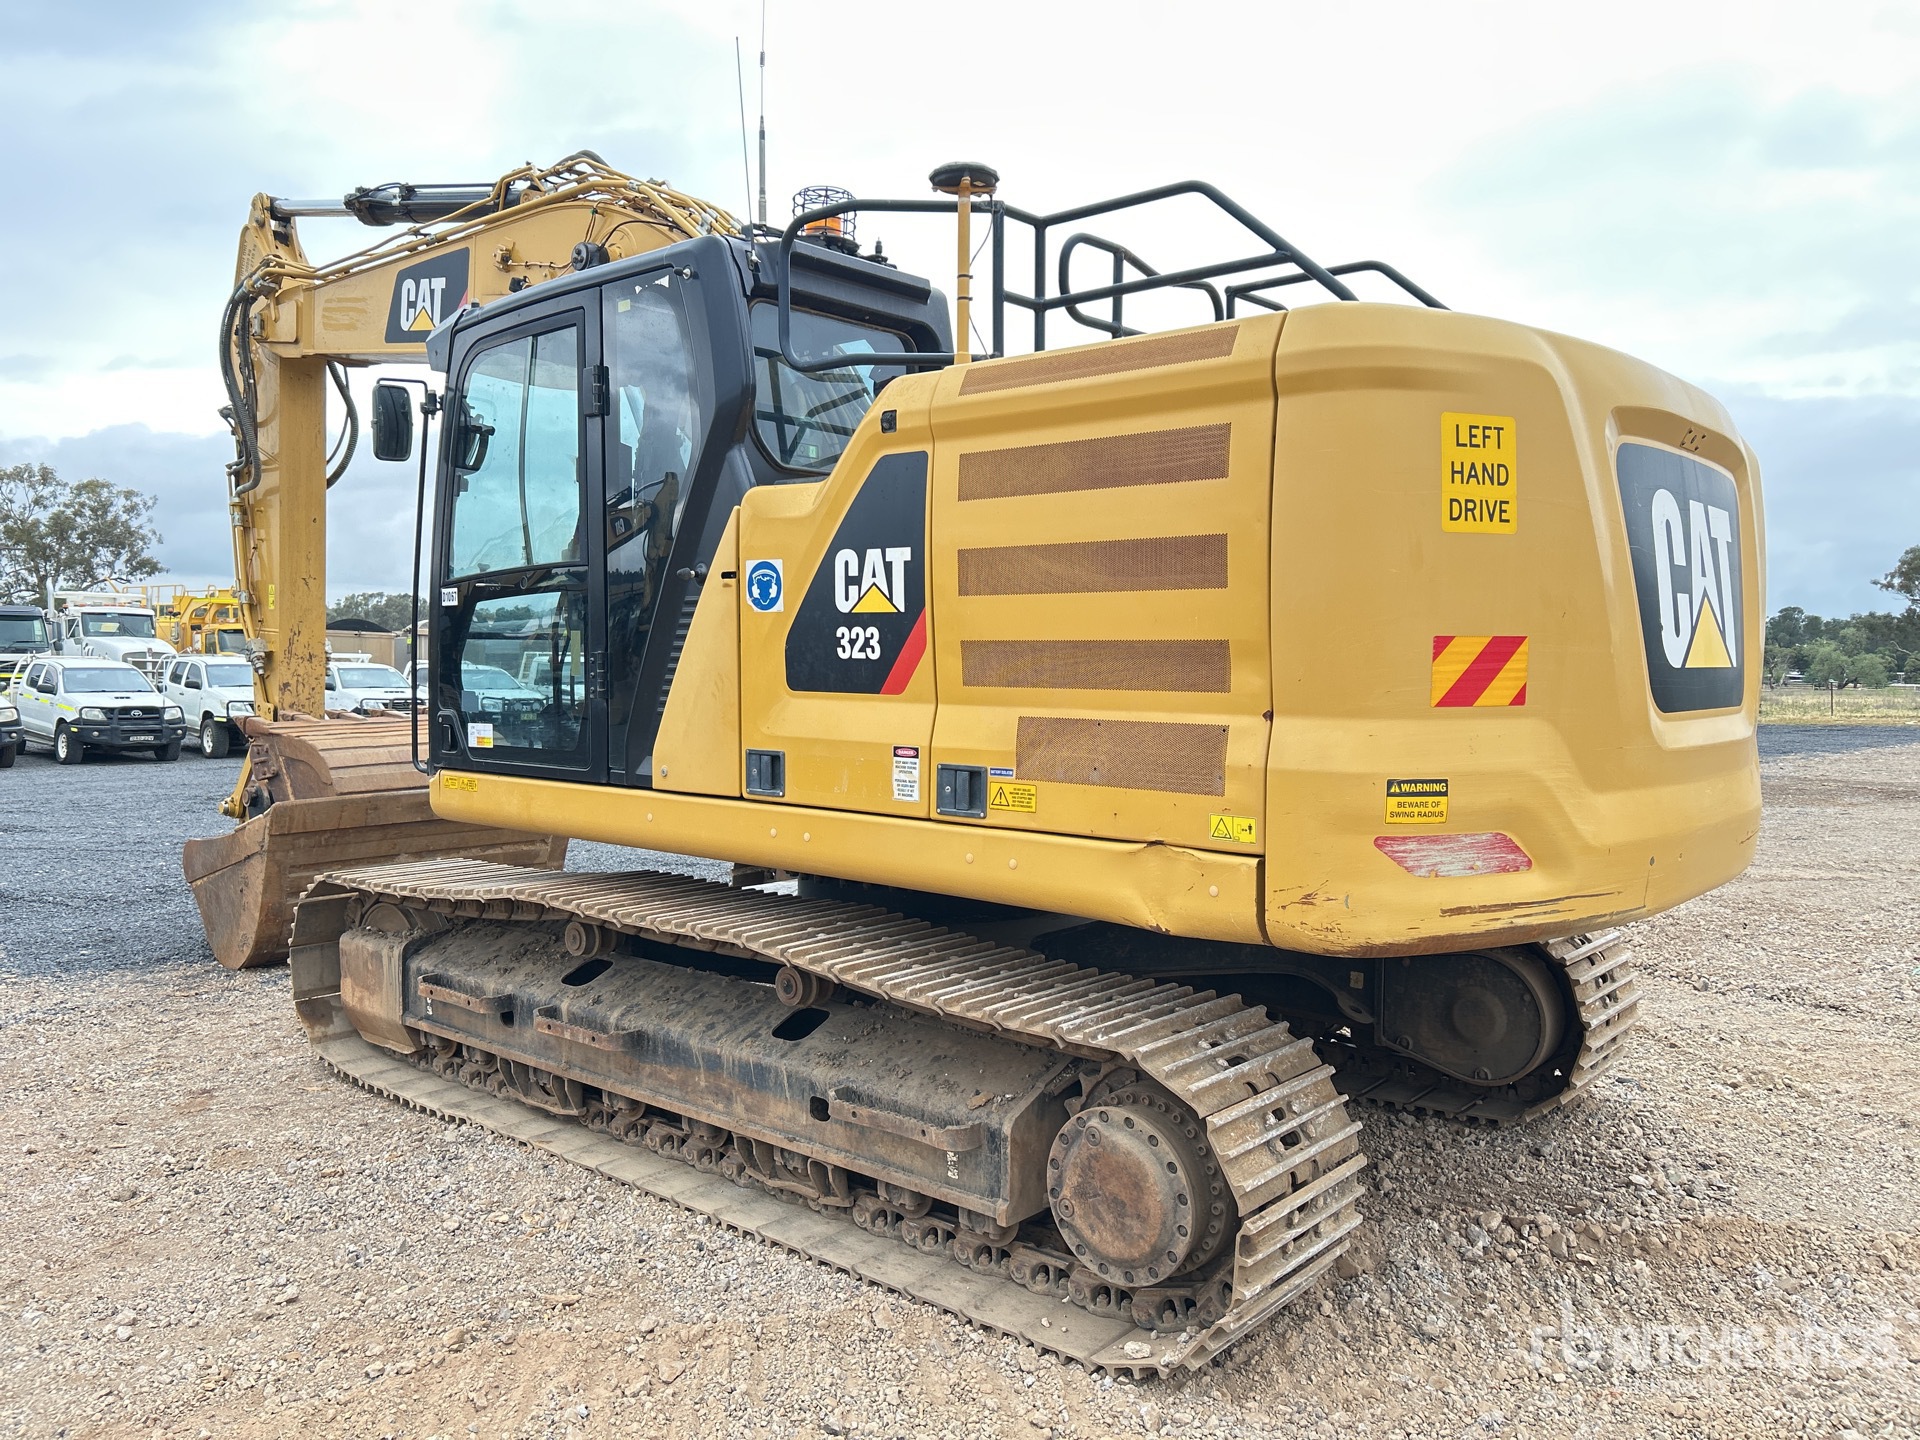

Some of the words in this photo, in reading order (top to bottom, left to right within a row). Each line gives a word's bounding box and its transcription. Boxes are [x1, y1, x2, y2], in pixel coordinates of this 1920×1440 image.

[400, 277, 446, 332] CAT
[1455, 423, 1505, 450] LEFT
[1450, 460, 1510, 487] HAND
[1449, 498, 1511, 523] DRIVE
[834, 547, 911, 614] CAT
[1651, 488, 1737, 669] CAT
[835, 626, 881, 660] 323
[1400, 783, 1447, 793] WARNING
[1397, 801, 1430, 809] BEWARE
[1430, 801, 1441, 809] OF
